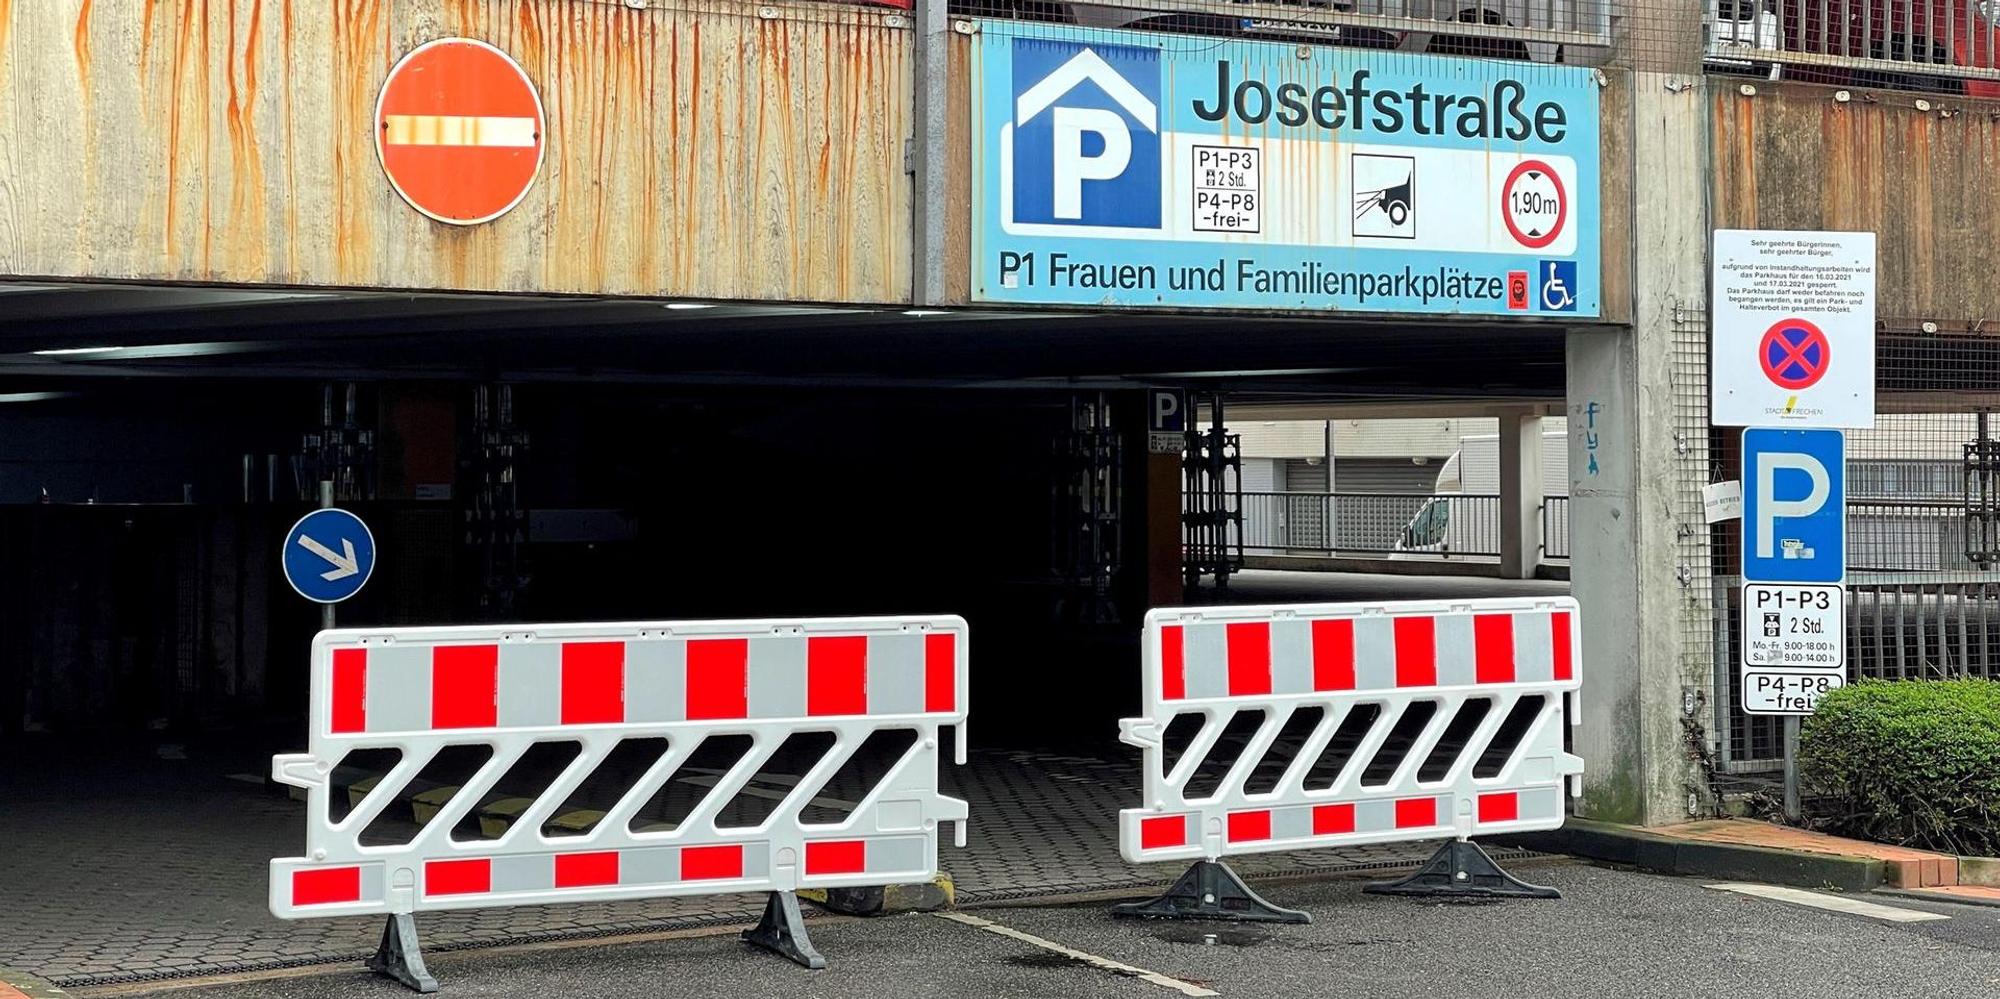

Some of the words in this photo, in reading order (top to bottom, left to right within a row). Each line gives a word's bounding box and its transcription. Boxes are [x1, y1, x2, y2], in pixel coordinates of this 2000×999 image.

[1193, 60, 1567, 143] Josefstraße
[1053, 107, 1133, 220] P
[1200, 151, 1252, 169] P1-P3
[1219, 171, 1225, 186] 2
[1229, 171, 1246, 187] Std.
[1198, 192, 1254, 211] P4-P8
[1203, 211, 1250, 227] -frei-
[1808, 249, 1833, 257] Bürger,
[1000, 251, 1034, 286] P1
[1050, 253, 1155, 289] Frauen
[1169, 259, 1224, 291] und
[1238, 260, 1503, 304] Familienparkplätze
[1755, 272, 1787, 280] Parkhaus
[1729, 296, 1763, 304] begangen
[1156, 393, 1177, 428] P
[1757, 452, 1831, 559] P
[1757, 590, 1829, 609] P1-P3
[1790, 617, 1797, 633] 2
[1802, 617, 1824, 634] Std.
[1829, 642, 1835, 650] h
[1753, 653, 1765, 661] Sa.
[1829, 654, 1835, 662] h
[1758, 676, 1829, 694] P4-P8
[1765, 693, 1812, 709] -frei
